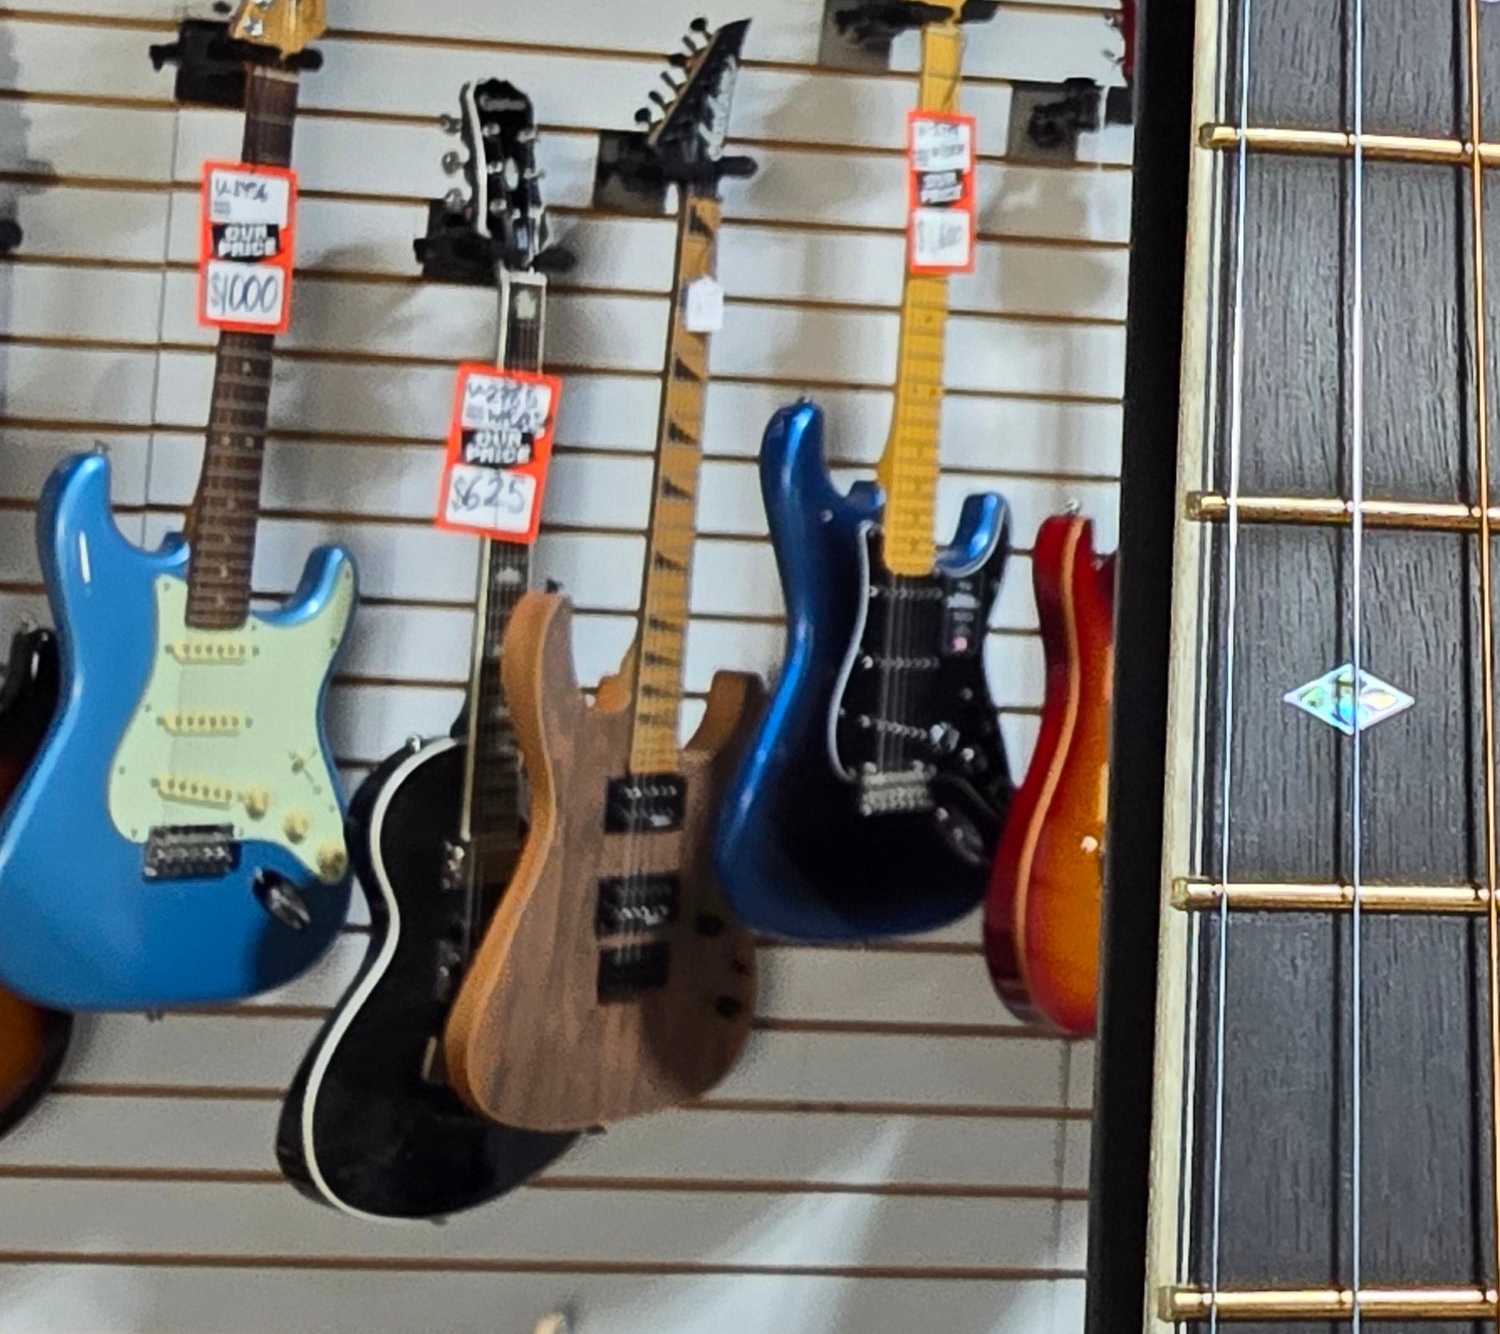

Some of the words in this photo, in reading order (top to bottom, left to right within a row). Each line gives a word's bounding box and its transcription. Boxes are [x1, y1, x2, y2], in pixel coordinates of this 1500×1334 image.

[224, 224, 268, 242] OUR
[217, 237, 277, 257] PRICE
[211, 271, 279, 315] $1000
[474, 429, 522, 449] OUR
[465, 443, 532, 464] PRICE
[451, 474, 526, 515] $625
